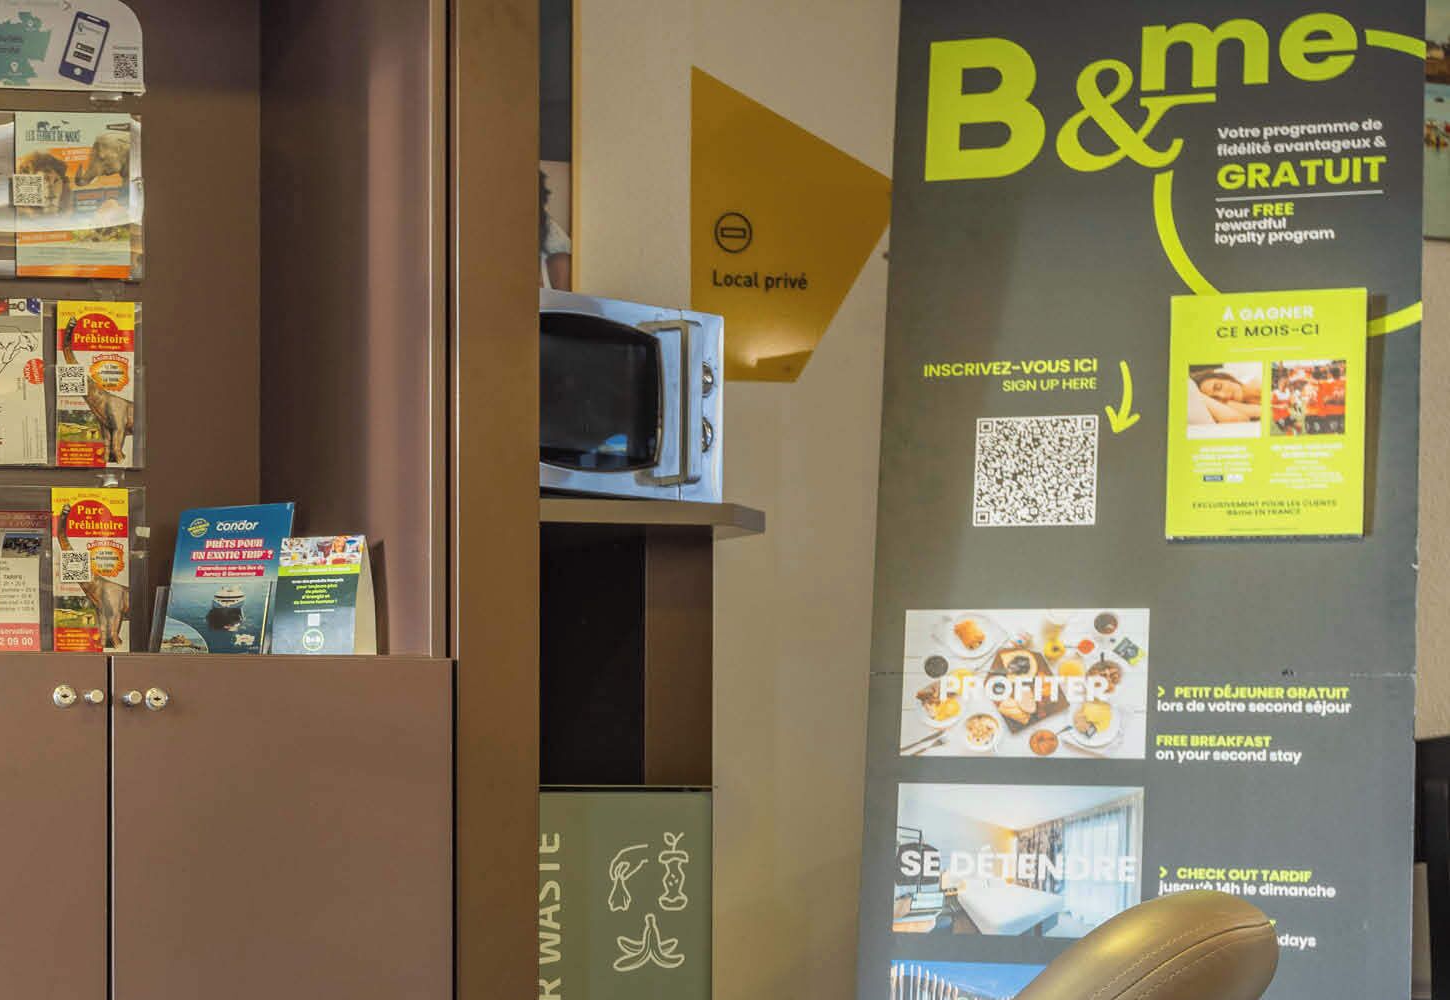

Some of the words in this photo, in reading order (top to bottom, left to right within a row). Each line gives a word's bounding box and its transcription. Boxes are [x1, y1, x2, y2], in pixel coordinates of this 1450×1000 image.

[925, 12, 1358, 181] B&me
[1217, 126, 1260, 140] Votre
[1262, 119, 1350, 138] programme
[1353, 118, 1383, 132] de
[1216, 139, 1271, 157] fidélité
[1274, 137, 1371, 155] avantageux
[1373, 136, 1387, 148] &
[1216, 156, 1386, 190] GRATUIT
[1216, 206, 1251, 219] Your
[1253, 203, 1294, 217] FREE
[1215, 217, 1287, 231] rewardful
[1215, 229, 1266, 246] loyalty
[1268, 227, 1335, 245] program
[713, 270, 759, 288] Local
[765, 271, 807, 292] privé
[1239, 306, 1314, 321] GAGNER
[83, 318, 111, 329] Parc
[1216, 327, 1238, 339] CE
[1244, 324, 1320, 338] MOIS-CI
[73, 332, 130, 344] Préhistoire
[924, 361, 1072, 378] INSCRIVEZ-VOUS
[1074, 359, 1098, 373] ICI
[1002, 379, 1037, 393] SIGN
[1040, 378, 1059, 392] UP
[1061, 377, 1097, 391] HERE
[77, 505, 105, 515] Parc
[68, 519, 124, 531] Préhistoire
[216, 520, 259, 531] condor
[206, 538, 236, 548] PRÊTS
[237, 539, 263, 548] POUR
[193, 551, 205, 560] UN
[207, 550, 241, 560] EXOTIC
[7, 637, 19, 646] 09
[22, 637, 34, 646] 00
[939, 675, 1109, 703] PROFITER
[1174, 686, 1211, 699] PETIT
[1213, 683, 1284, 700] DÉJEUNER
[1287, 686, 1349, 700] GRATUIT
[1157, 700, 1182, 712] lors
[1185, 700, 1205, 712] de
[1207, 701, 1245, 713] votre
[1248, 700, 1302, 713] second
[1305, 700, 1352, 717] séjour
[1156, 735, 1189, 747] FREE
[1190, 735, 1272, 748] BREAKFAST
[1156, 750, 1169, 760] on
[1172, 751, 1210, 764] your
[1213, 748, 1266, 762] second
[1269, 749, 1302, 765] stay
[900, 850, 940, 877] SE
[951, 845, 1136, 882] DÉTENDRE
[1177, 867, 1225, 881] CHECK
[1228, 869, 1258, 881] OUT
[1261, 869, 1312, 882] TARDIF
[1216, 882, 1240, 895] 14h
[1242, 883, 1256, 895] le
[1258, 883, 1336, 898] dimanche
[1277, 934, 1317, 948] days
